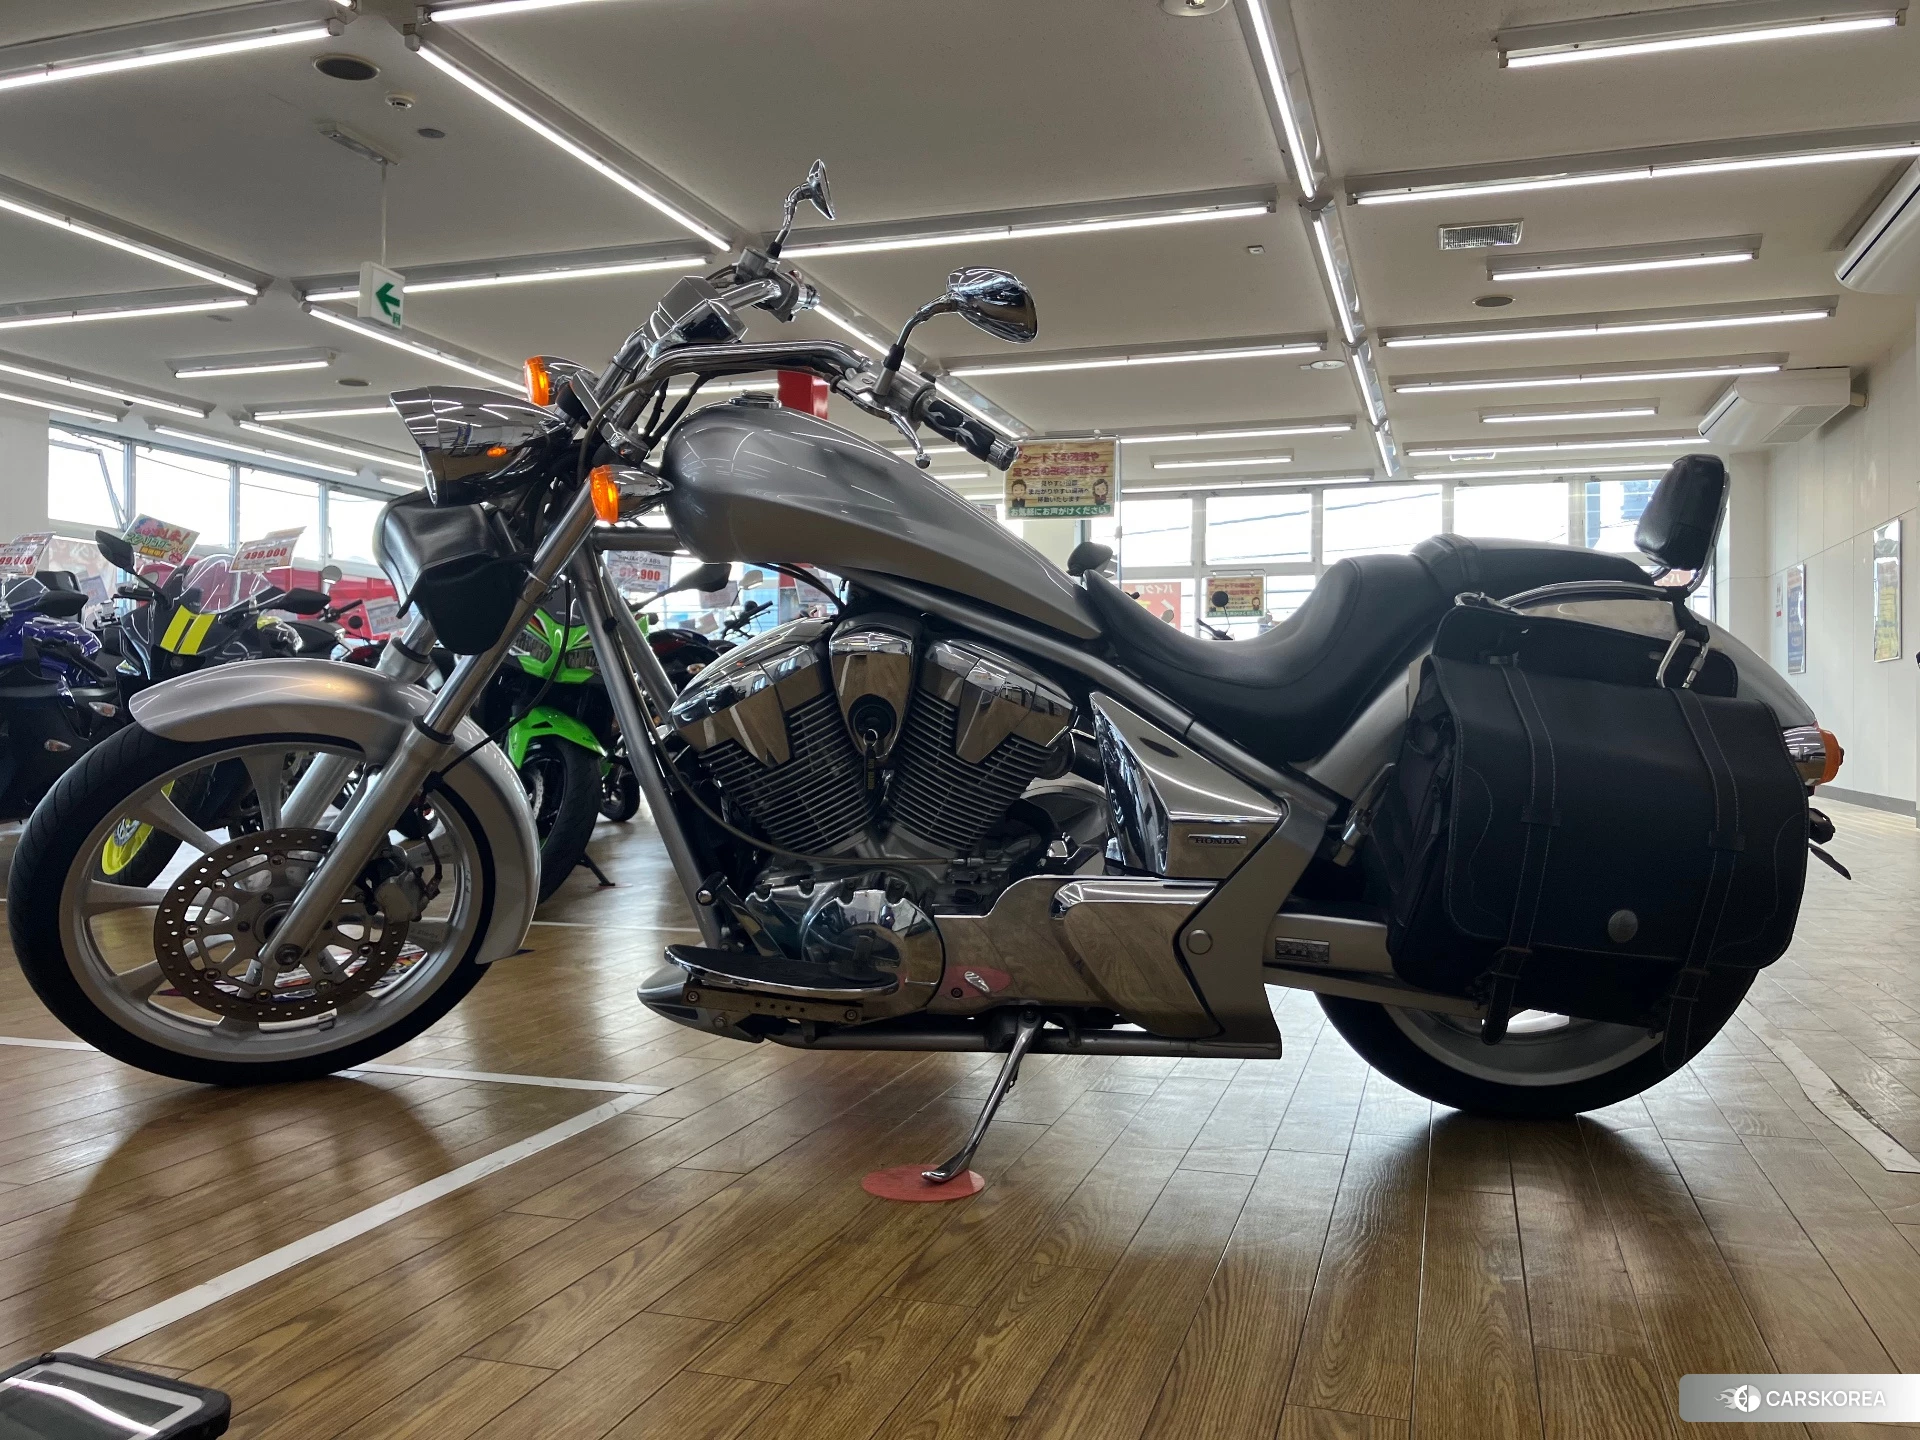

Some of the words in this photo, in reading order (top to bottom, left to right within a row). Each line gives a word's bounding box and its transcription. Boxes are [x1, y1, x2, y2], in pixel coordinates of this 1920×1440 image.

[1010, 506, 1109, 517] お気軽にお声がけください
[1194, 836, 1241, 845] HONDA
